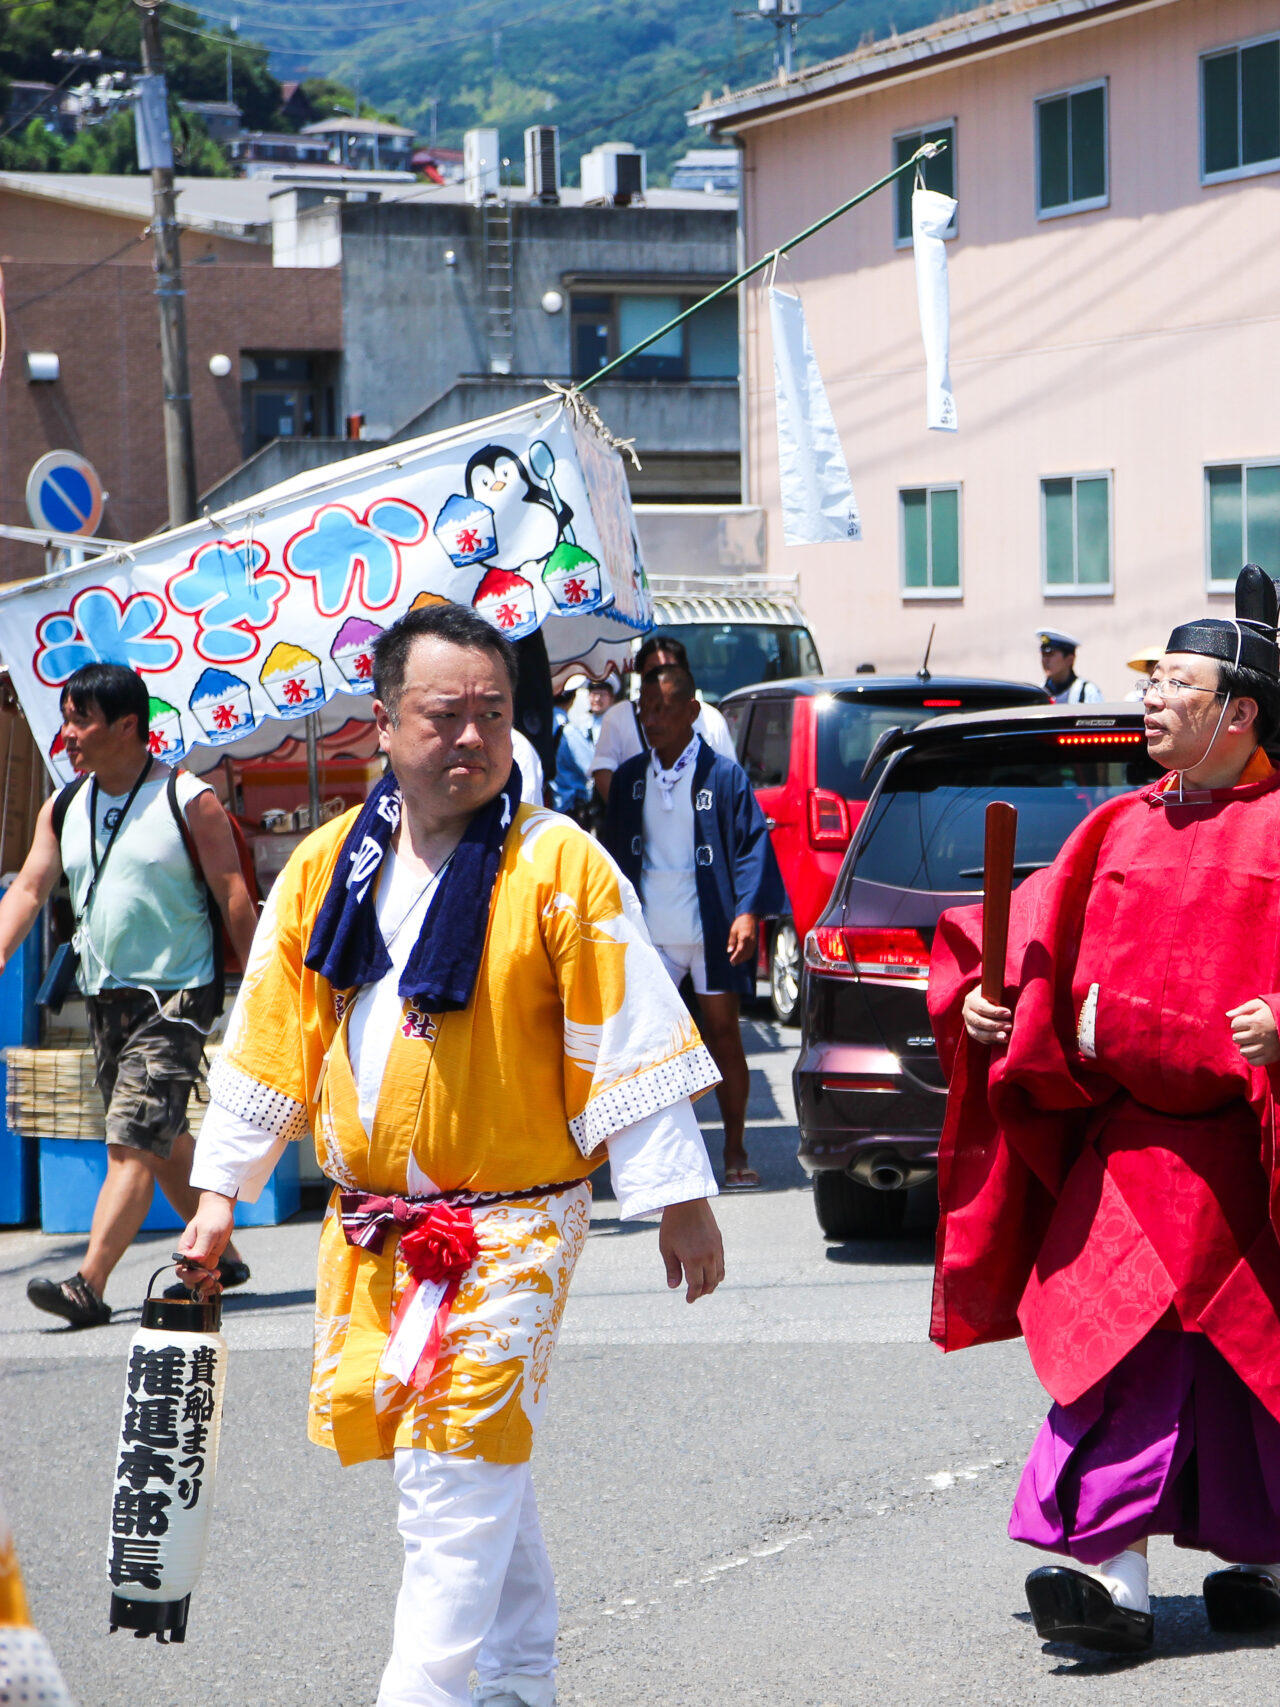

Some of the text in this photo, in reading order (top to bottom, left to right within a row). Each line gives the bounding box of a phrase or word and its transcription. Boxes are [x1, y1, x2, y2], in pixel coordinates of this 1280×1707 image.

[455, 528, 482, 553] 氷
[563, 578, 589, 604] 氷
[495, 603, 522, 628] 氷
[283, 678, 310, 705] 氷
[212, 704, 239, 730] 氷
[178, 1344, 218, 1510] 貴船まつり
[108, 1345, 187, 1591] 推進本部長
